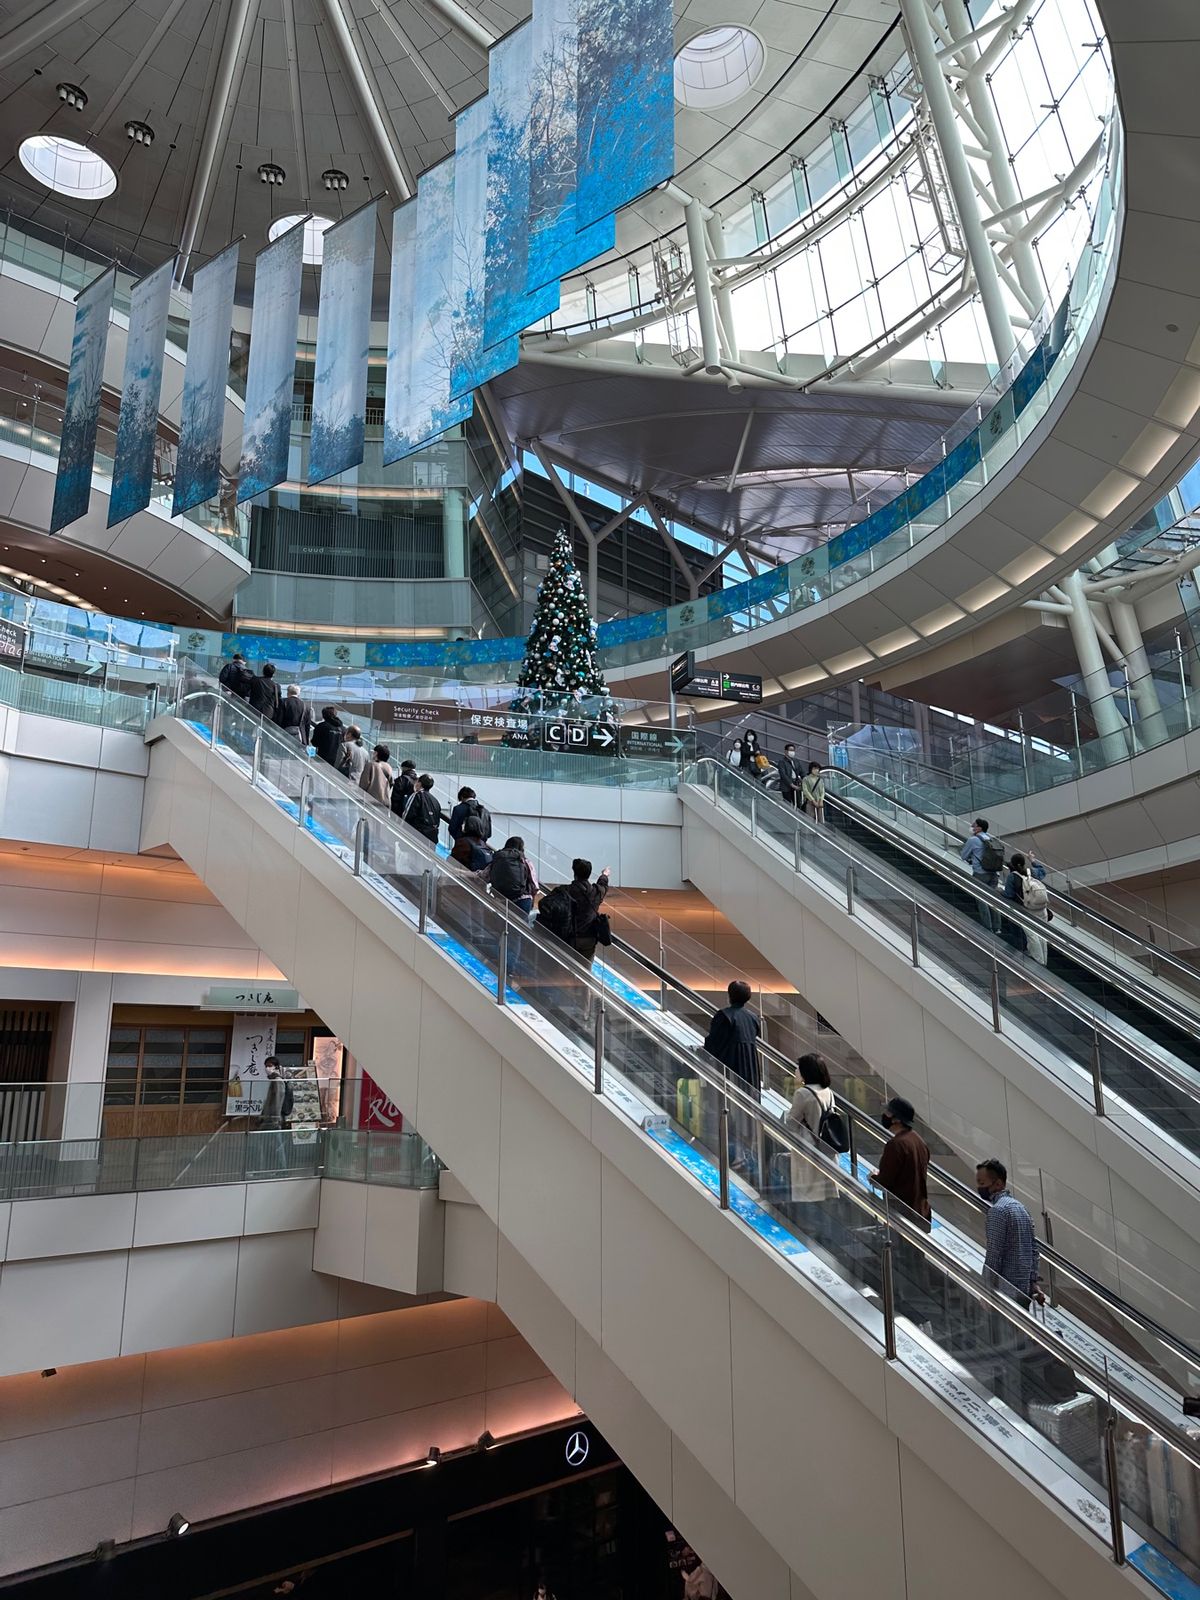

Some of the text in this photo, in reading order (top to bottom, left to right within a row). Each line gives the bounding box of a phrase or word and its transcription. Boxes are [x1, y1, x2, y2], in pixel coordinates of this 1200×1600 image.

[0, 624, 17, 637] heck
[394, 706, 418, 714] Security
[471, 714, 528, 731] 保安検査場
[549, 726, 585, 742] C D
